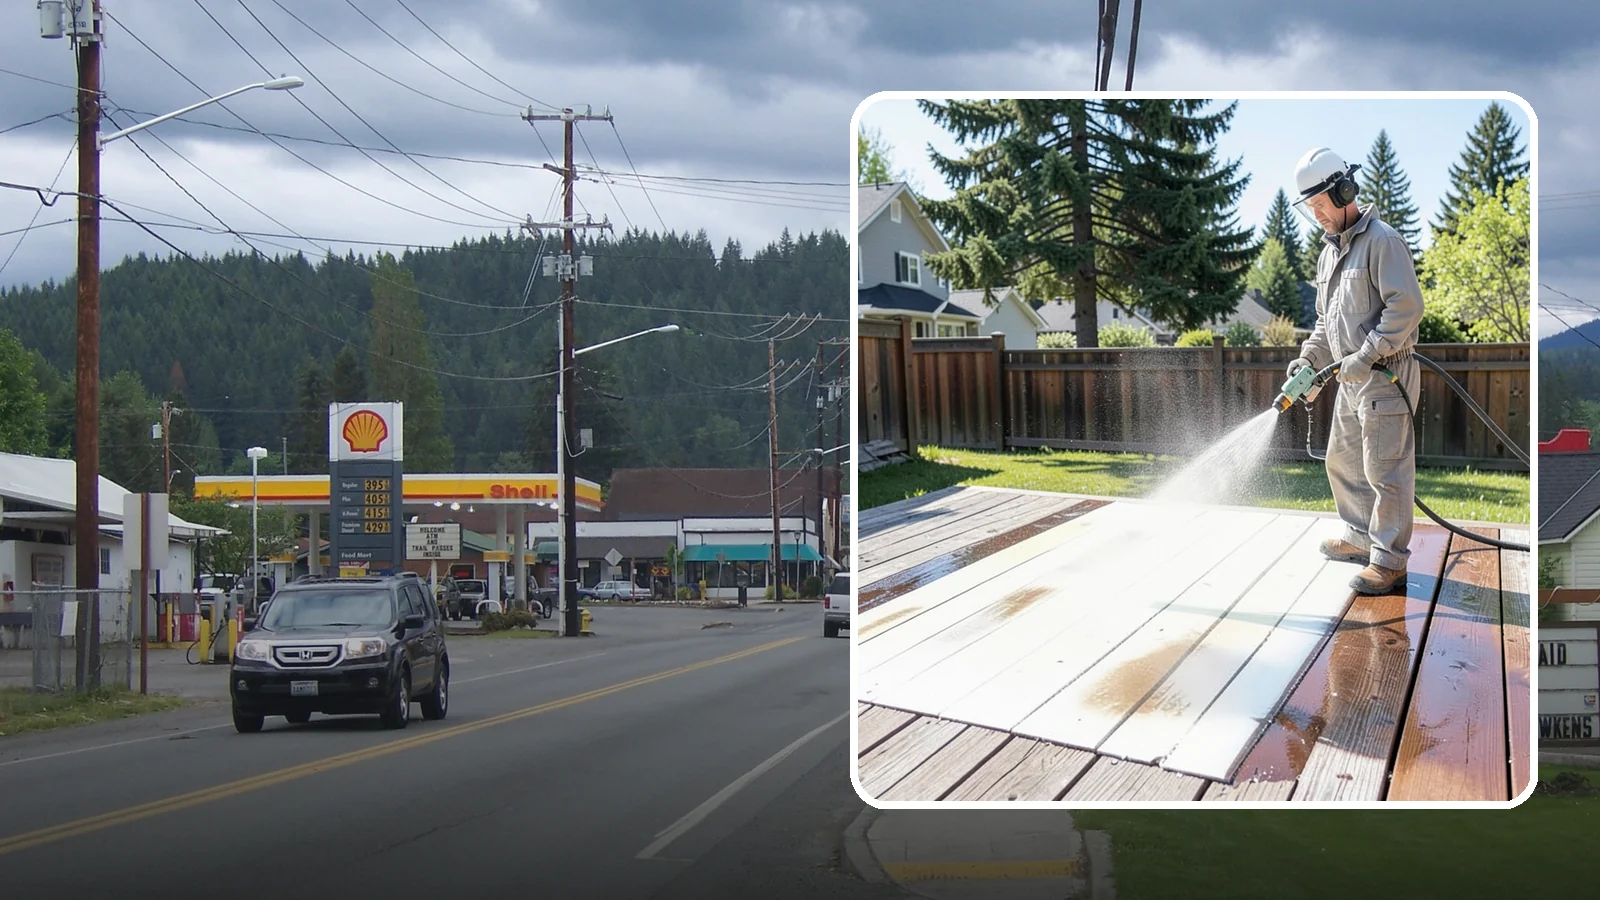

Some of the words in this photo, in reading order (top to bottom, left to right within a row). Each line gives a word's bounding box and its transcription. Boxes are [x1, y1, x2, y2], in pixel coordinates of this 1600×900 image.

[365, 480, 384, 490] 395
[490, 484, 547, 499] Shell
[365, 494, 384, 504] 405
[365, 508, 384, 518] 415
[365, 522, 384, 532] 429
[1539, 642, 1567, 665] AID
